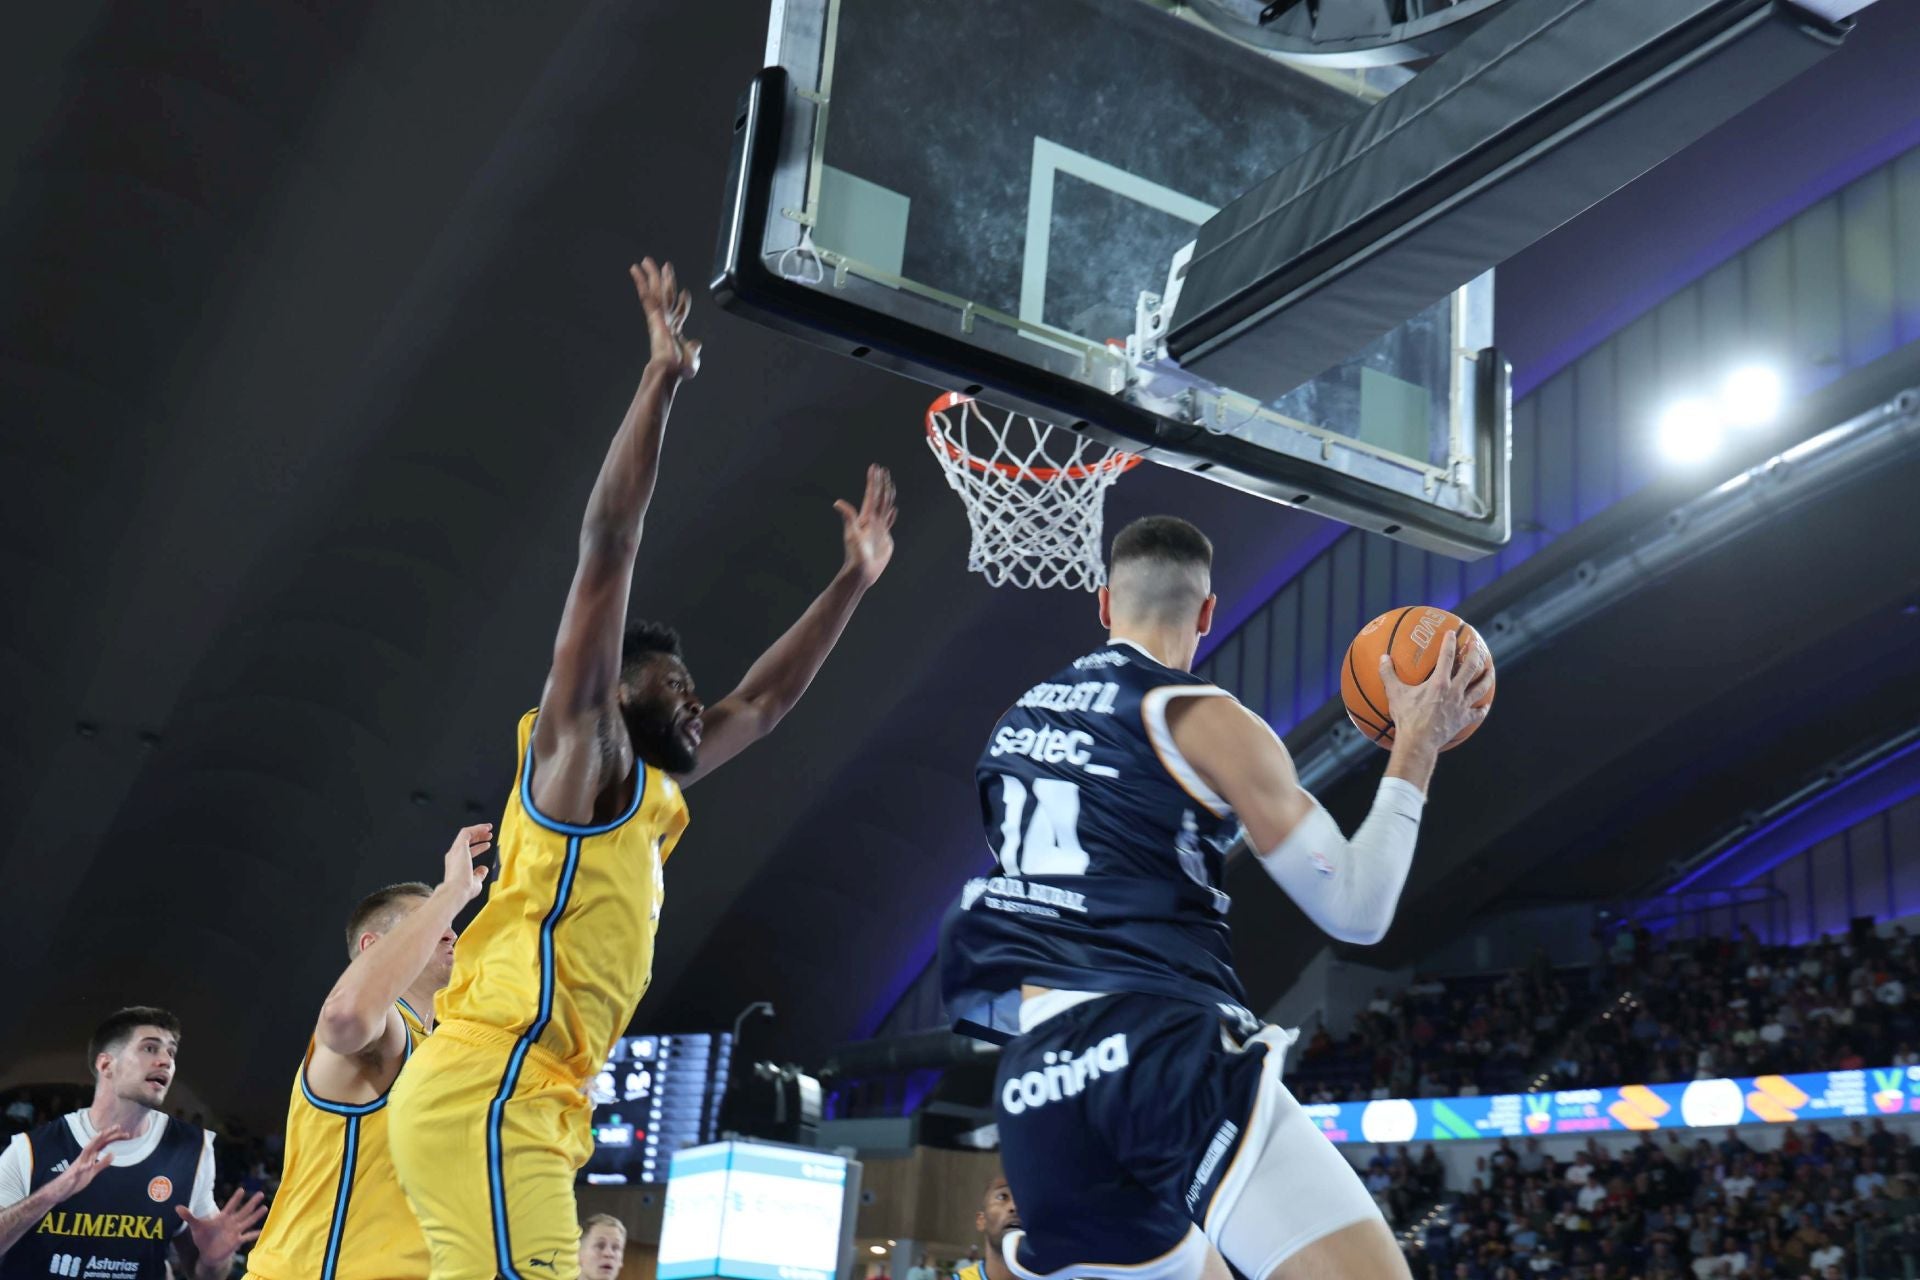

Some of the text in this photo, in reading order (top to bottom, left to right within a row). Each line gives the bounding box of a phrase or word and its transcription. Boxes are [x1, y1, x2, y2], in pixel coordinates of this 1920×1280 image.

[1000, 773, 1090, 878] 14
[36, 1211, 164, 1239] ALIMERKA
[86, 1255, 140, 1272] Asturias
